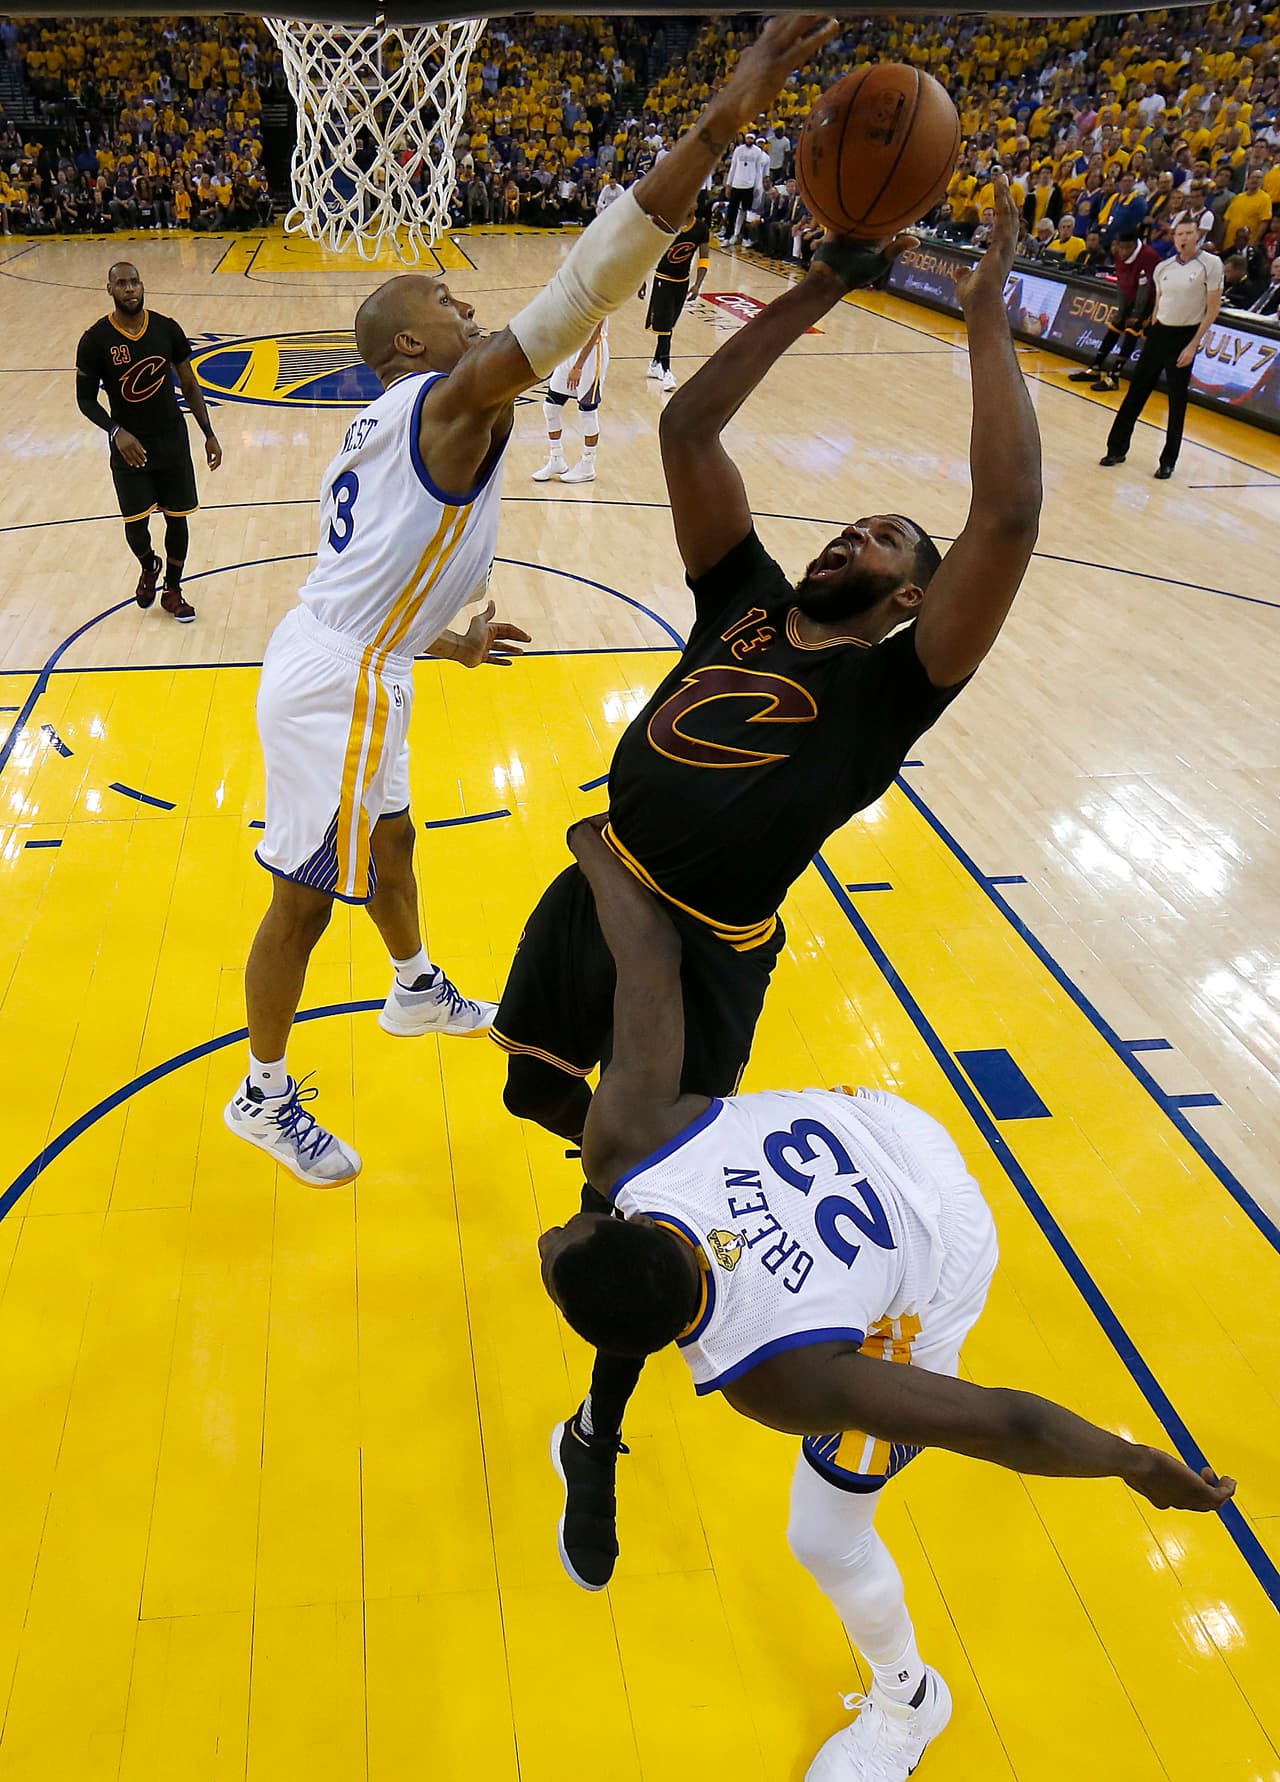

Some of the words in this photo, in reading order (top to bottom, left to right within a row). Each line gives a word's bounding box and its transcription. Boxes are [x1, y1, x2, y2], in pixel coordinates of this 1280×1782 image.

[110, 344, 132, 366] 23
[1250, 344, 1278, 372] 7
[327, 470, 359, 554] 3
[720, 607, 777, 661] 13
[763, 1118, 898, 1270] 23
[723, 1166, 814, 1294] GREEN
